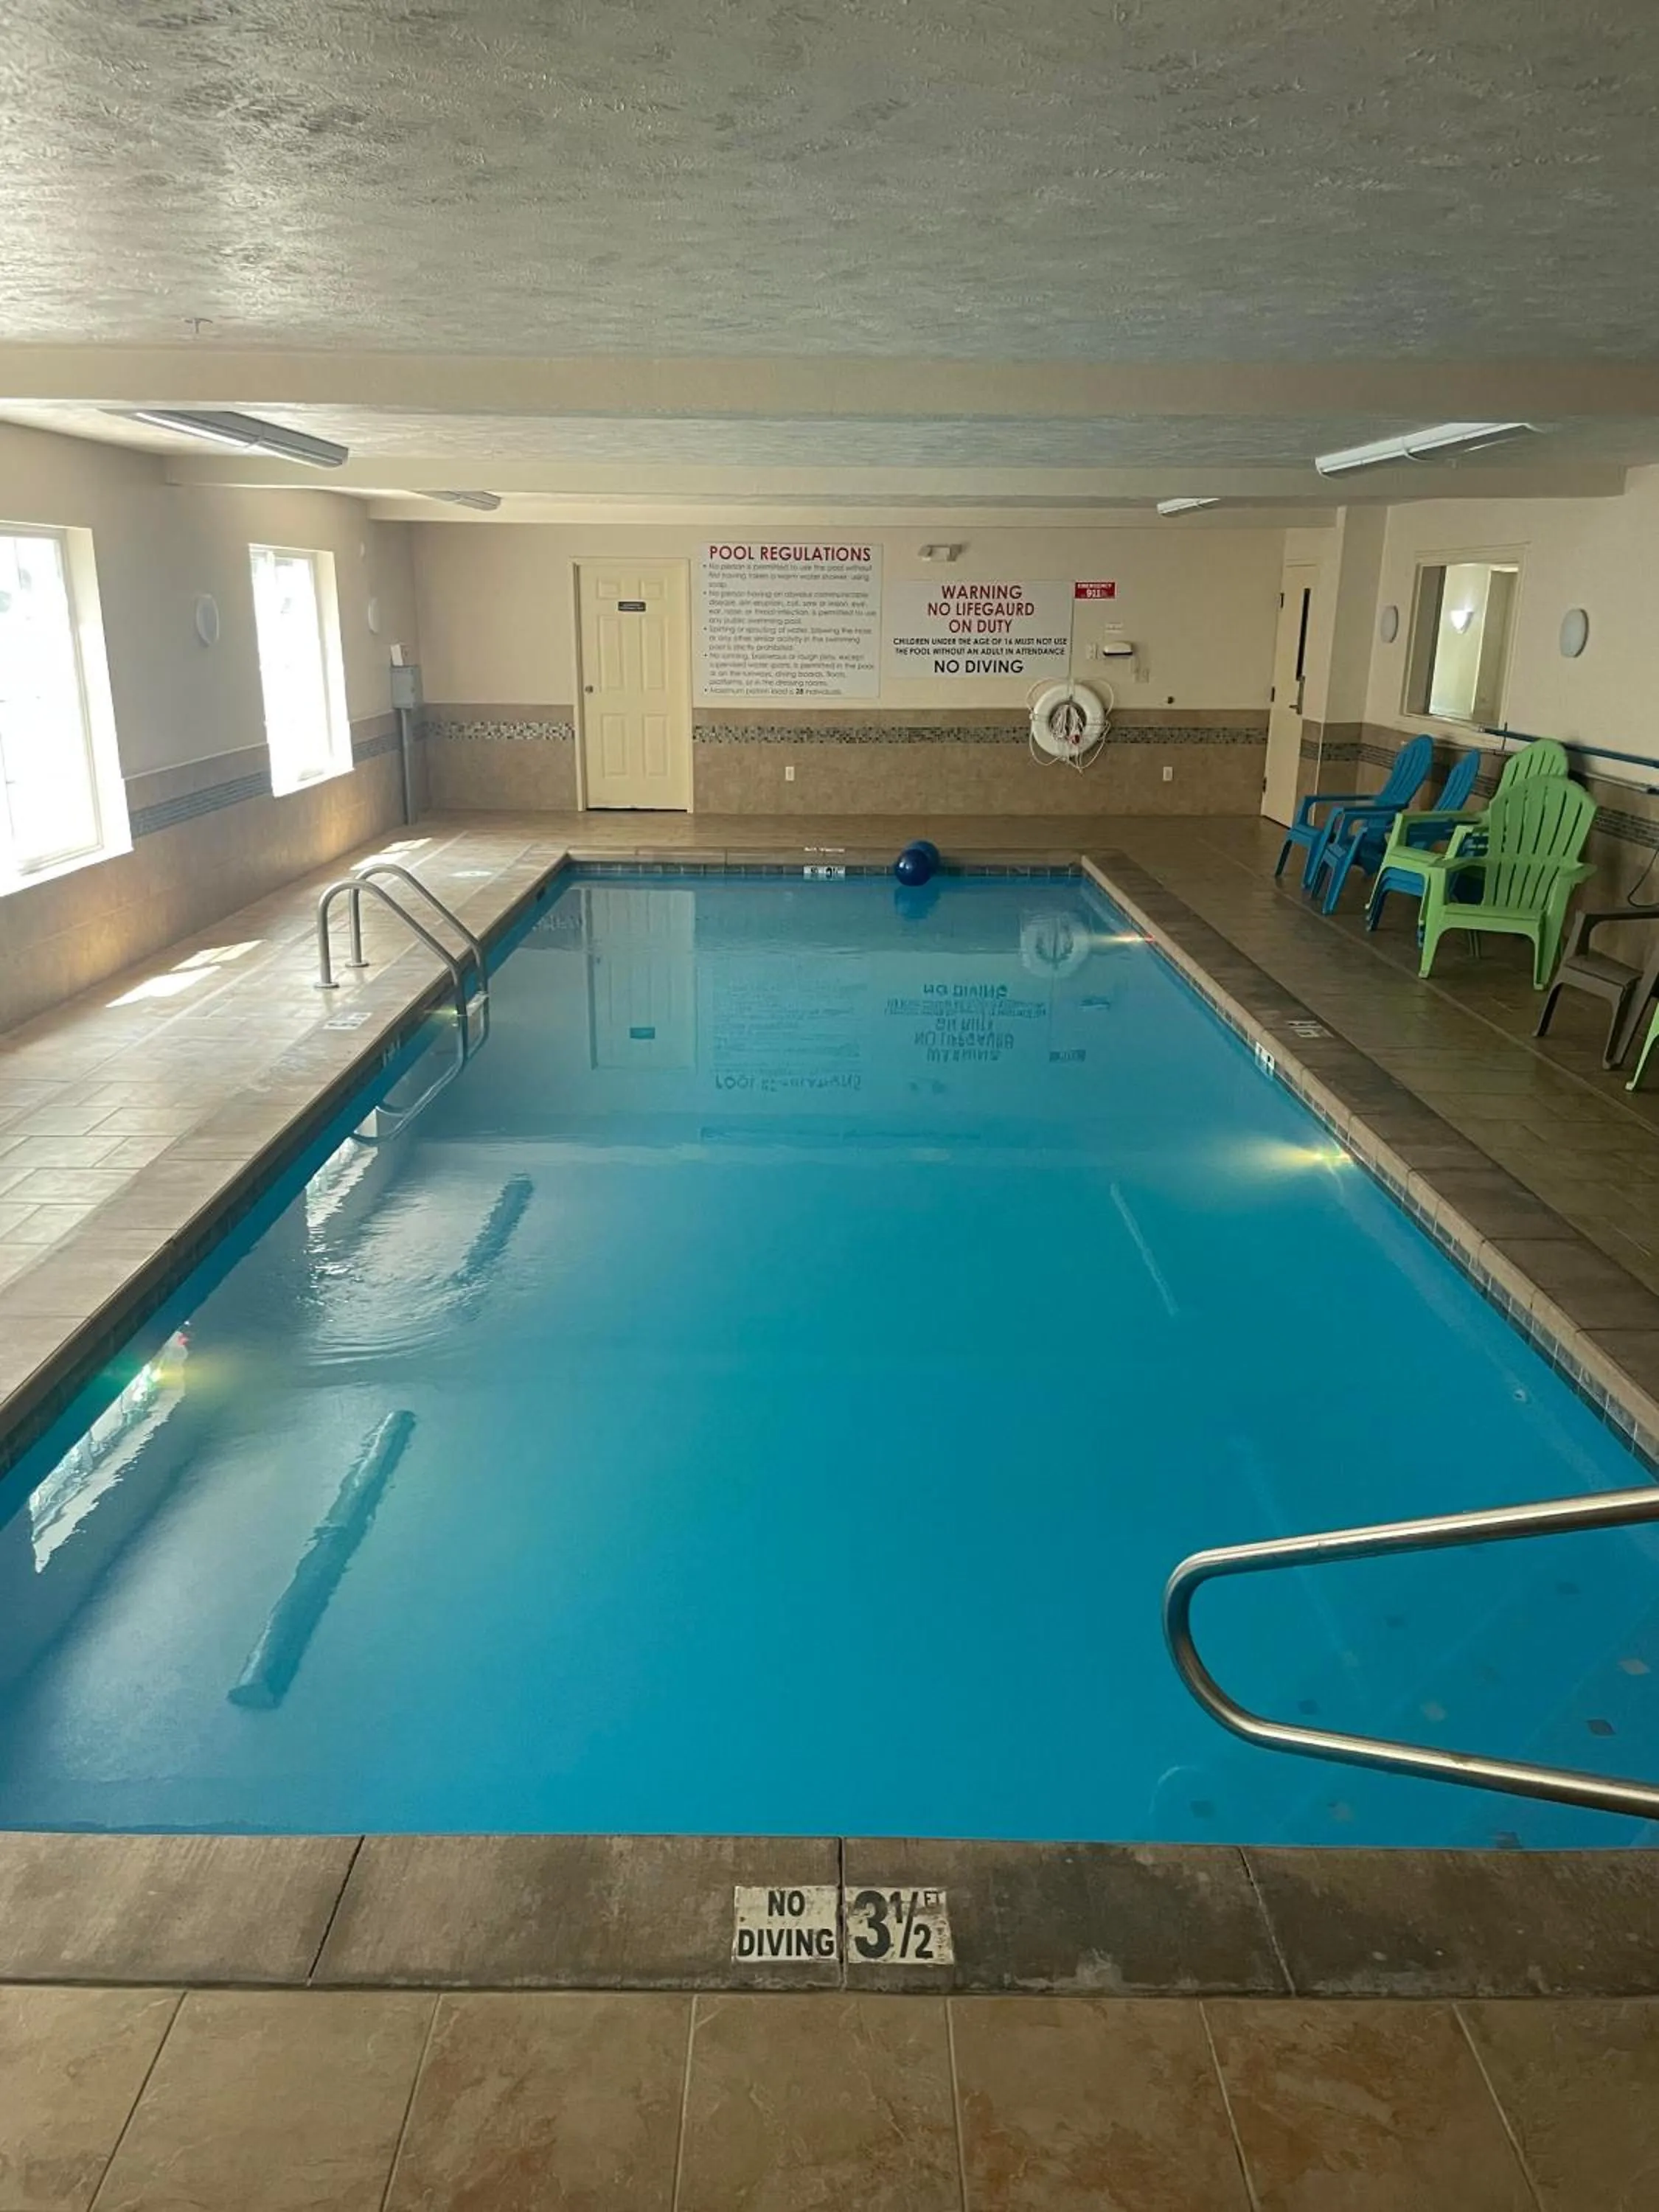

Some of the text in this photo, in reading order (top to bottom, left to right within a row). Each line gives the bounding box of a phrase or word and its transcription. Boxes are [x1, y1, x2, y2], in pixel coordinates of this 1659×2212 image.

[709, 546, 871, 561] POOL REGULATIONS
[942, 585, 1022, 599] WARNING
[1086, 589, 1101, 598] 911
[928, 602, 1034, 616] NO LIFEGAURD
[949, 619, 1012, 633] ON DUTY
[934, 660, 1023, 673] NO DIVING
[768, 1890, 805, 1916] NO
[738, 1927, 835, 1958] DIVING
